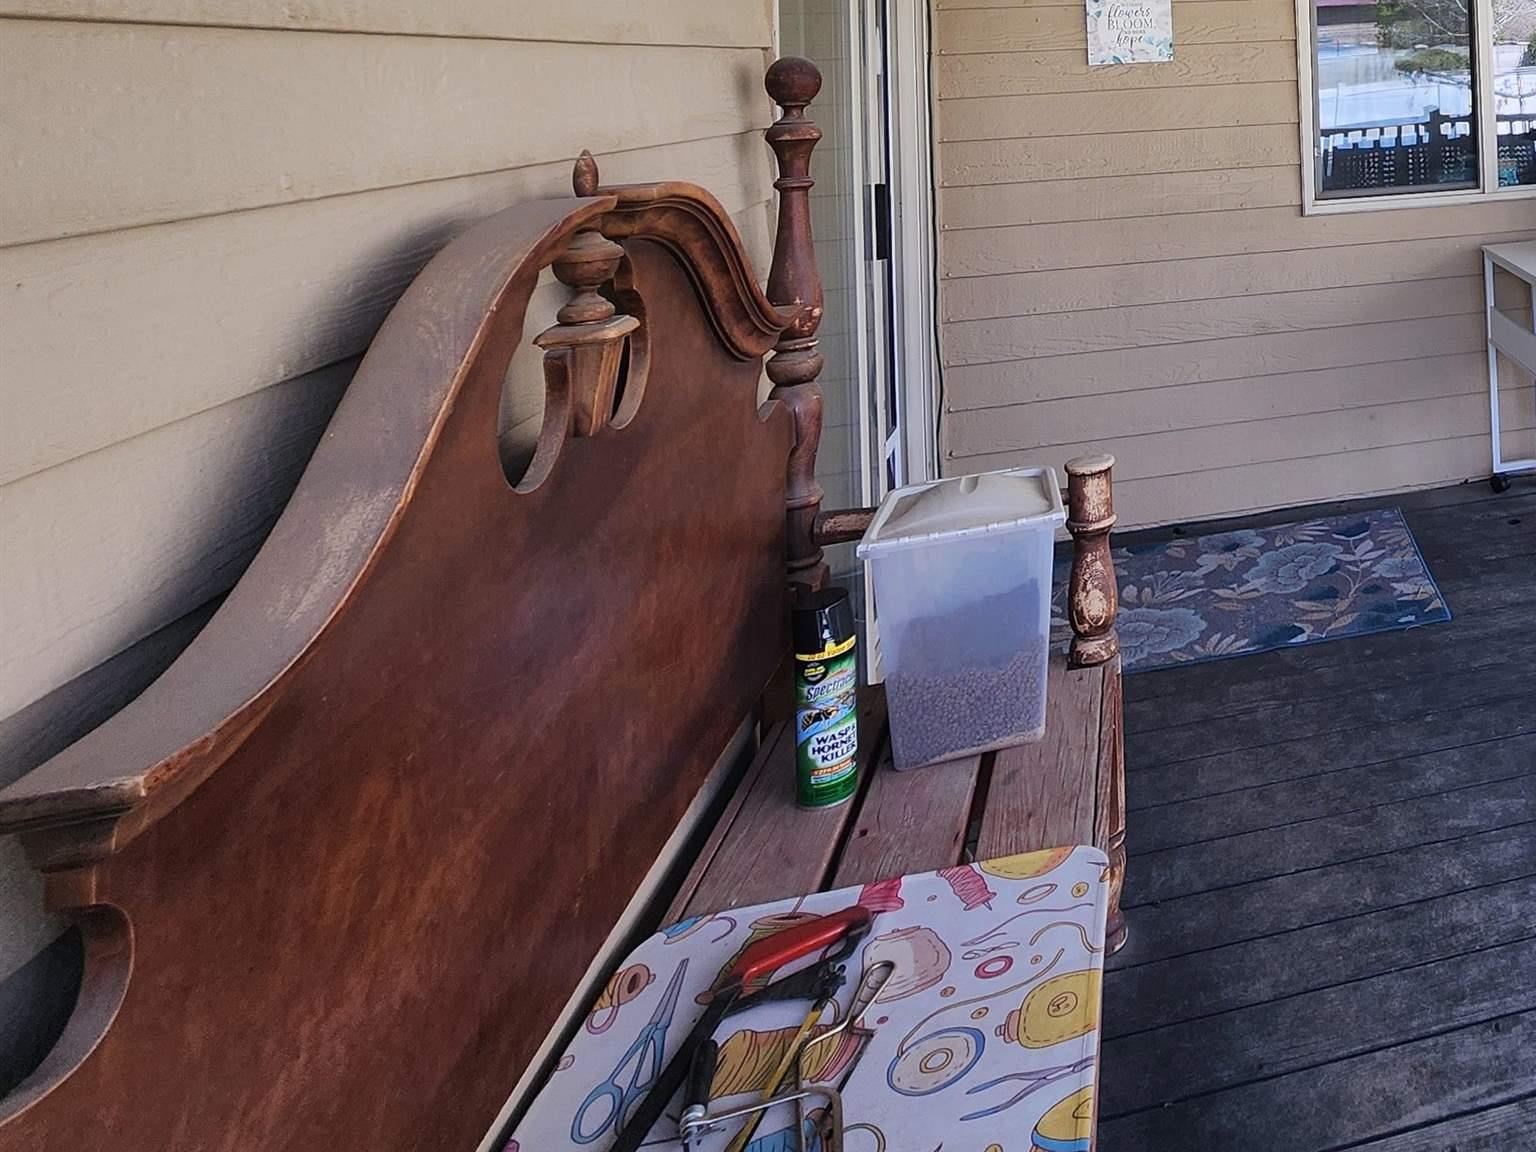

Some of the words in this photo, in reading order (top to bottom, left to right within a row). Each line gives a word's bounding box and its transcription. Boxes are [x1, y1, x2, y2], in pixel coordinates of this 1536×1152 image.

[1108, 3, 1151, 18] flowers
[1116, 29, 1144, 48] hope
[816, 726, 851, 745] WASP
